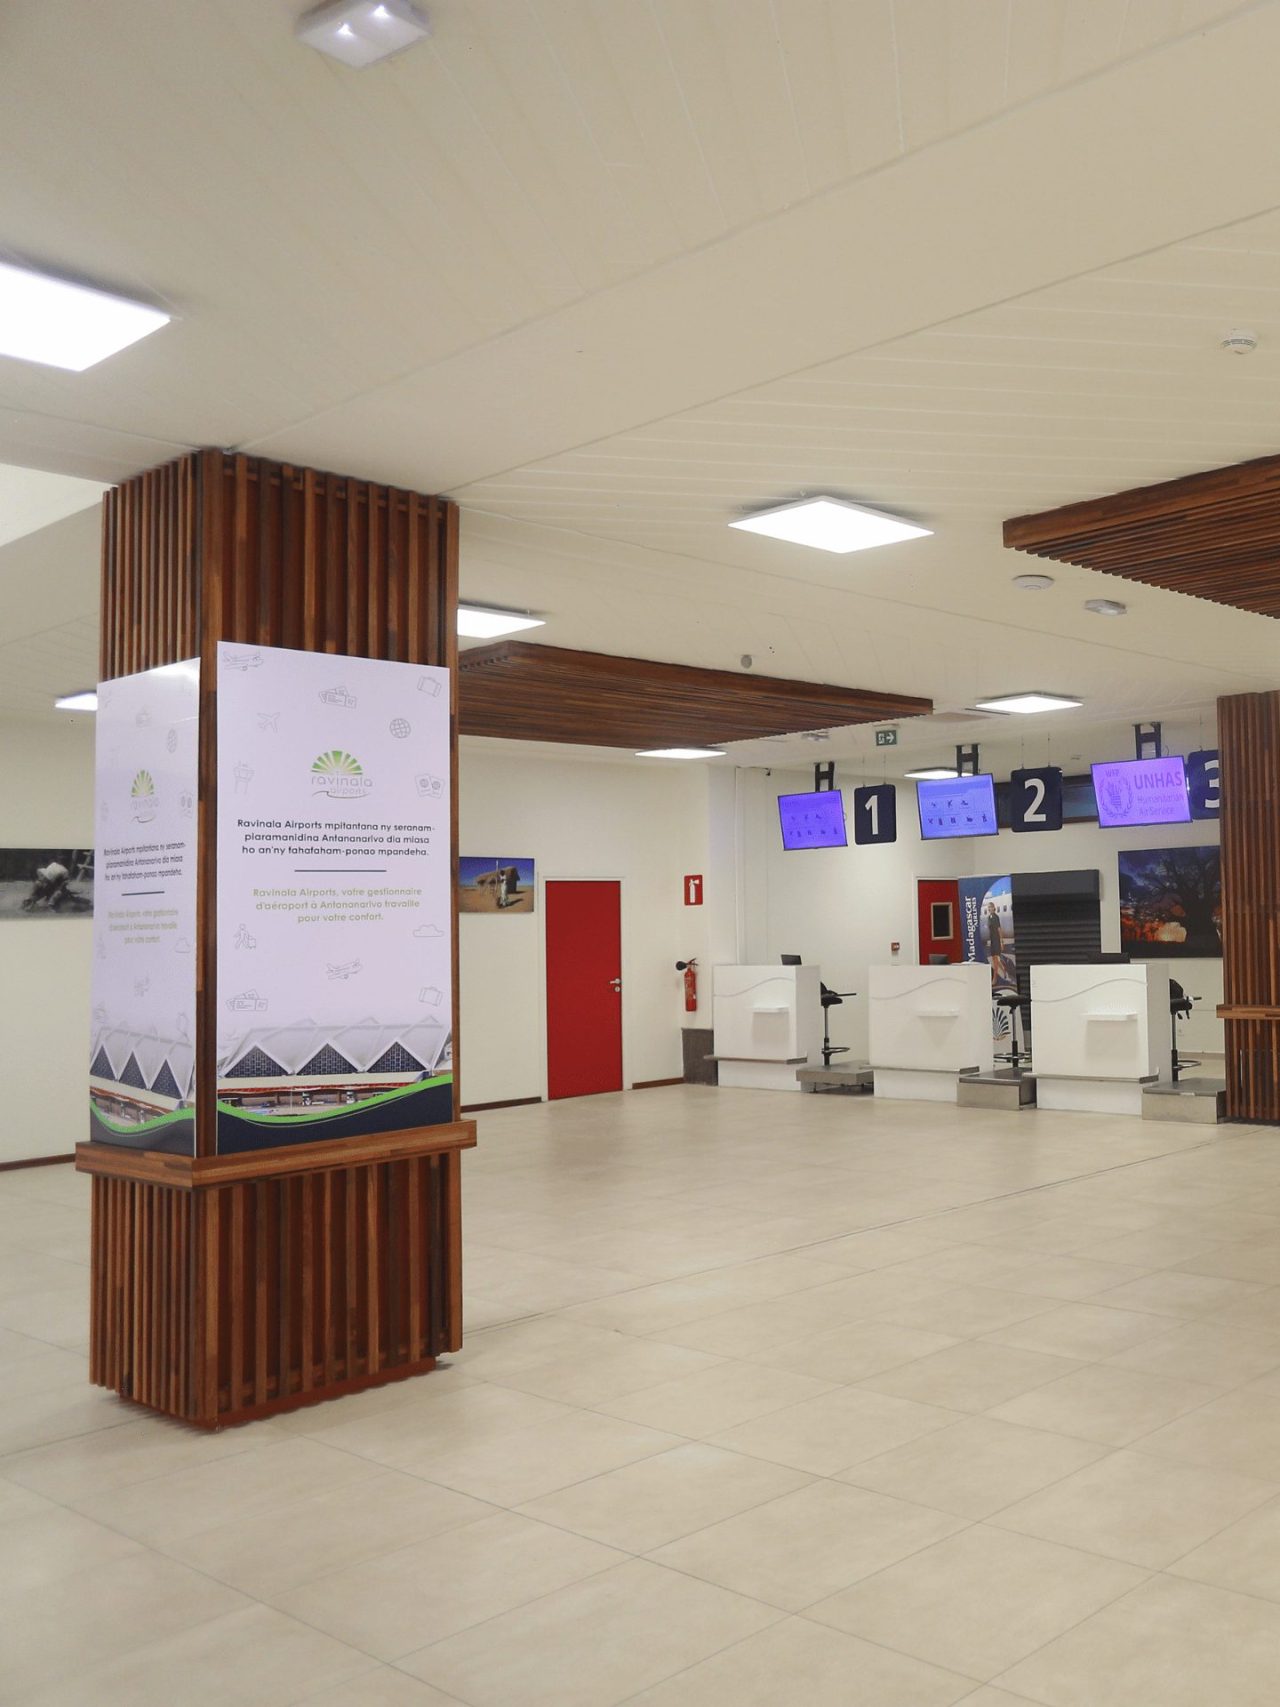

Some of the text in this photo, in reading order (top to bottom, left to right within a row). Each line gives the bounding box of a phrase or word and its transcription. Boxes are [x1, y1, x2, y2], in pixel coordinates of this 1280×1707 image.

[311, 775, 374, 787] ravinala
[1133, 771, 1183, 789] UNHAS
[1204, 759, 1220, 808] 3
[1023, 778, 1047, 822] 2
[864, 794, 879, 835] 1
[237, 818, 282, 829] Ravinala
[284, 820, 322, 831] Airports
[324, 821, 379, 832] mpitantana
[380, 824, 392, 833] ny
[244, 832, 430, 844] piaramanidina Antananarivo dia miasa
[242, 845, 430, 857] ho an'ny fahafaham-ponao mpandeha.
[252, 887, 422, 899] Ravinala Airports, votre gestionnaire
[256, 899, 420, 912] d'aéroport à Antananarivo travaille
[297, 912, 384, 923] pour votre confort.
[965, 896, 976, 962] Madagascar
